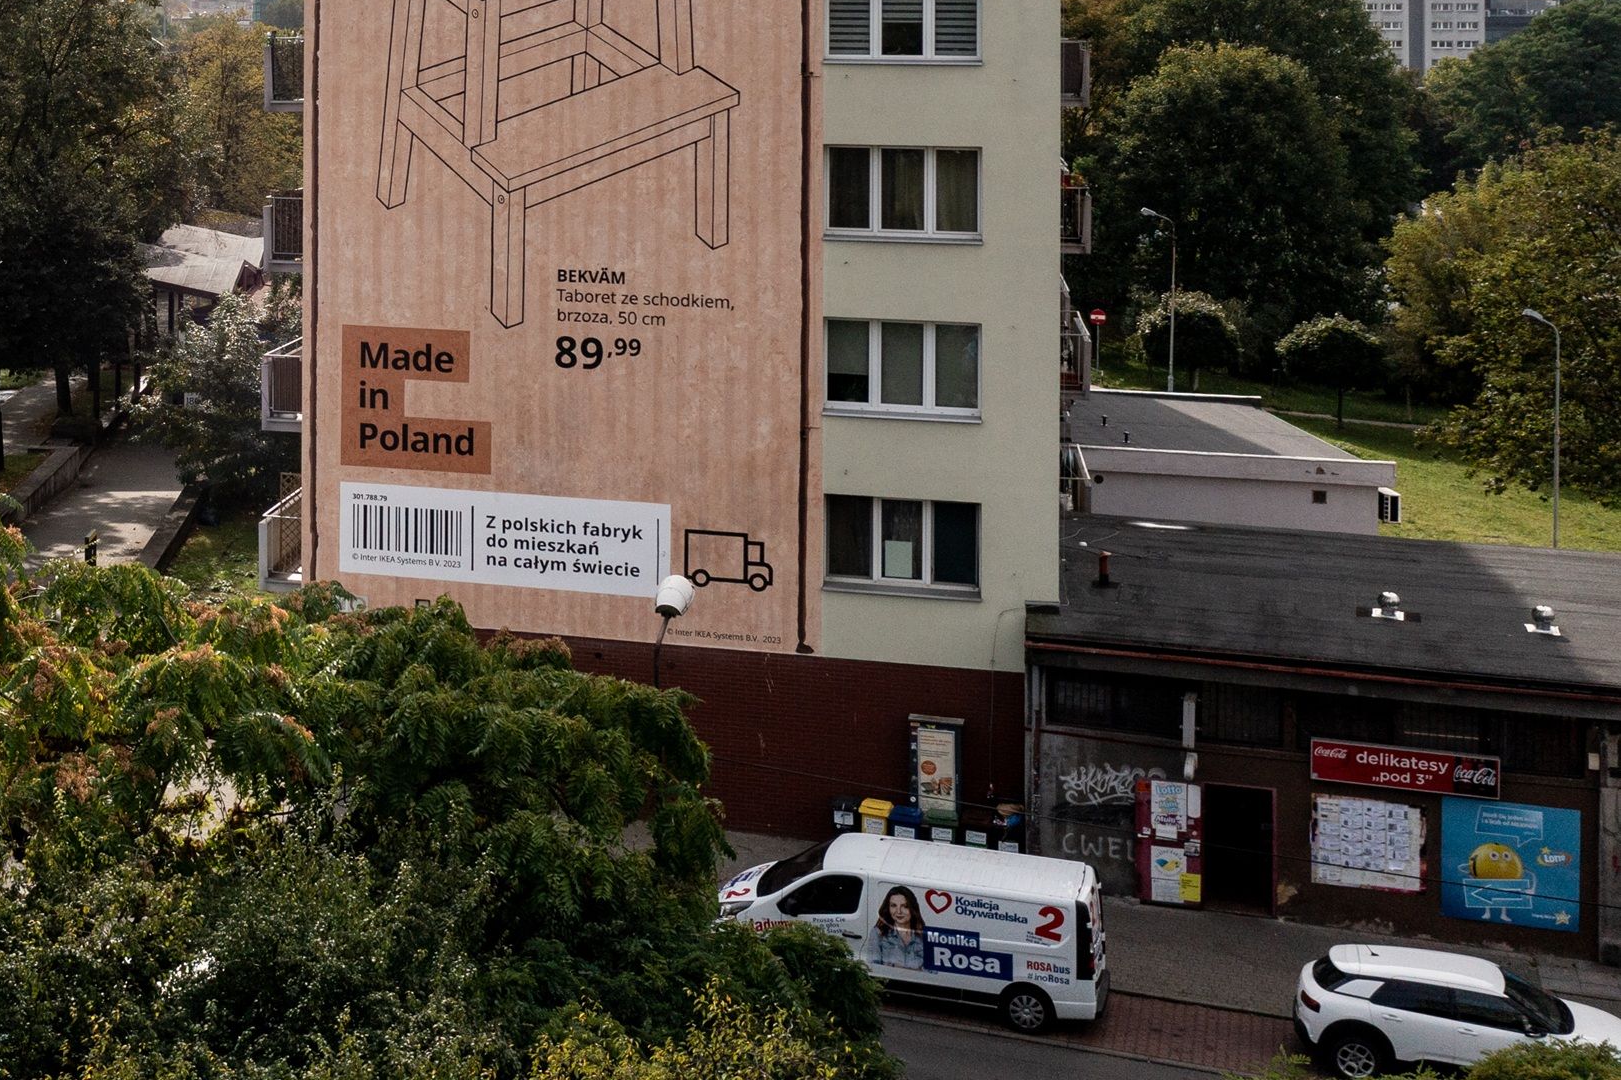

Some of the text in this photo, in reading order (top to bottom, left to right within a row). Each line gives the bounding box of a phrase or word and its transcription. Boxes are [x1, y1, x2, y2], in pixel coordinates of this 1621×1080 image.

[557, 268, 626, 285] BEKVÄM
[556, 288, 735, 311] Taboret ze schodkiem,
[557, 309, 666, 326] brzoza, 50 cm
[360, 341, 455, 373] Made
[360, 380, 389, 410] in
[360, 422, 474, 456] Poland
[352, 493, 388, 502] 301.788.79
[486, 515, 643, 543] Z polskich fabryk
[486, 533, 599, 556] do mieszkań
[360, 553, 378, 562] Inter
[379, 555, 395, 563] IKEA
[397, 556, 427, 566] Systems
[443, 560, 461, 569] 2023
[486, 554, 641, 578] na całym świecie
[675, 628, 693, 637] Inter
[694, 629, 711, 638] IKEA
[713, 631, 744, 641] Systems
[763, 635, 782, 644] 2023
[1356, 751, 1449, 774] delikatesy
[955, 905, 1028, 924] Obywatelska
[956, 896, 1000, 912] Koalicja
[1035, 905, 1065, 942] 2
[927, 931, 977, 948] Monika
[933, 946, 1001, 974] Rosa
